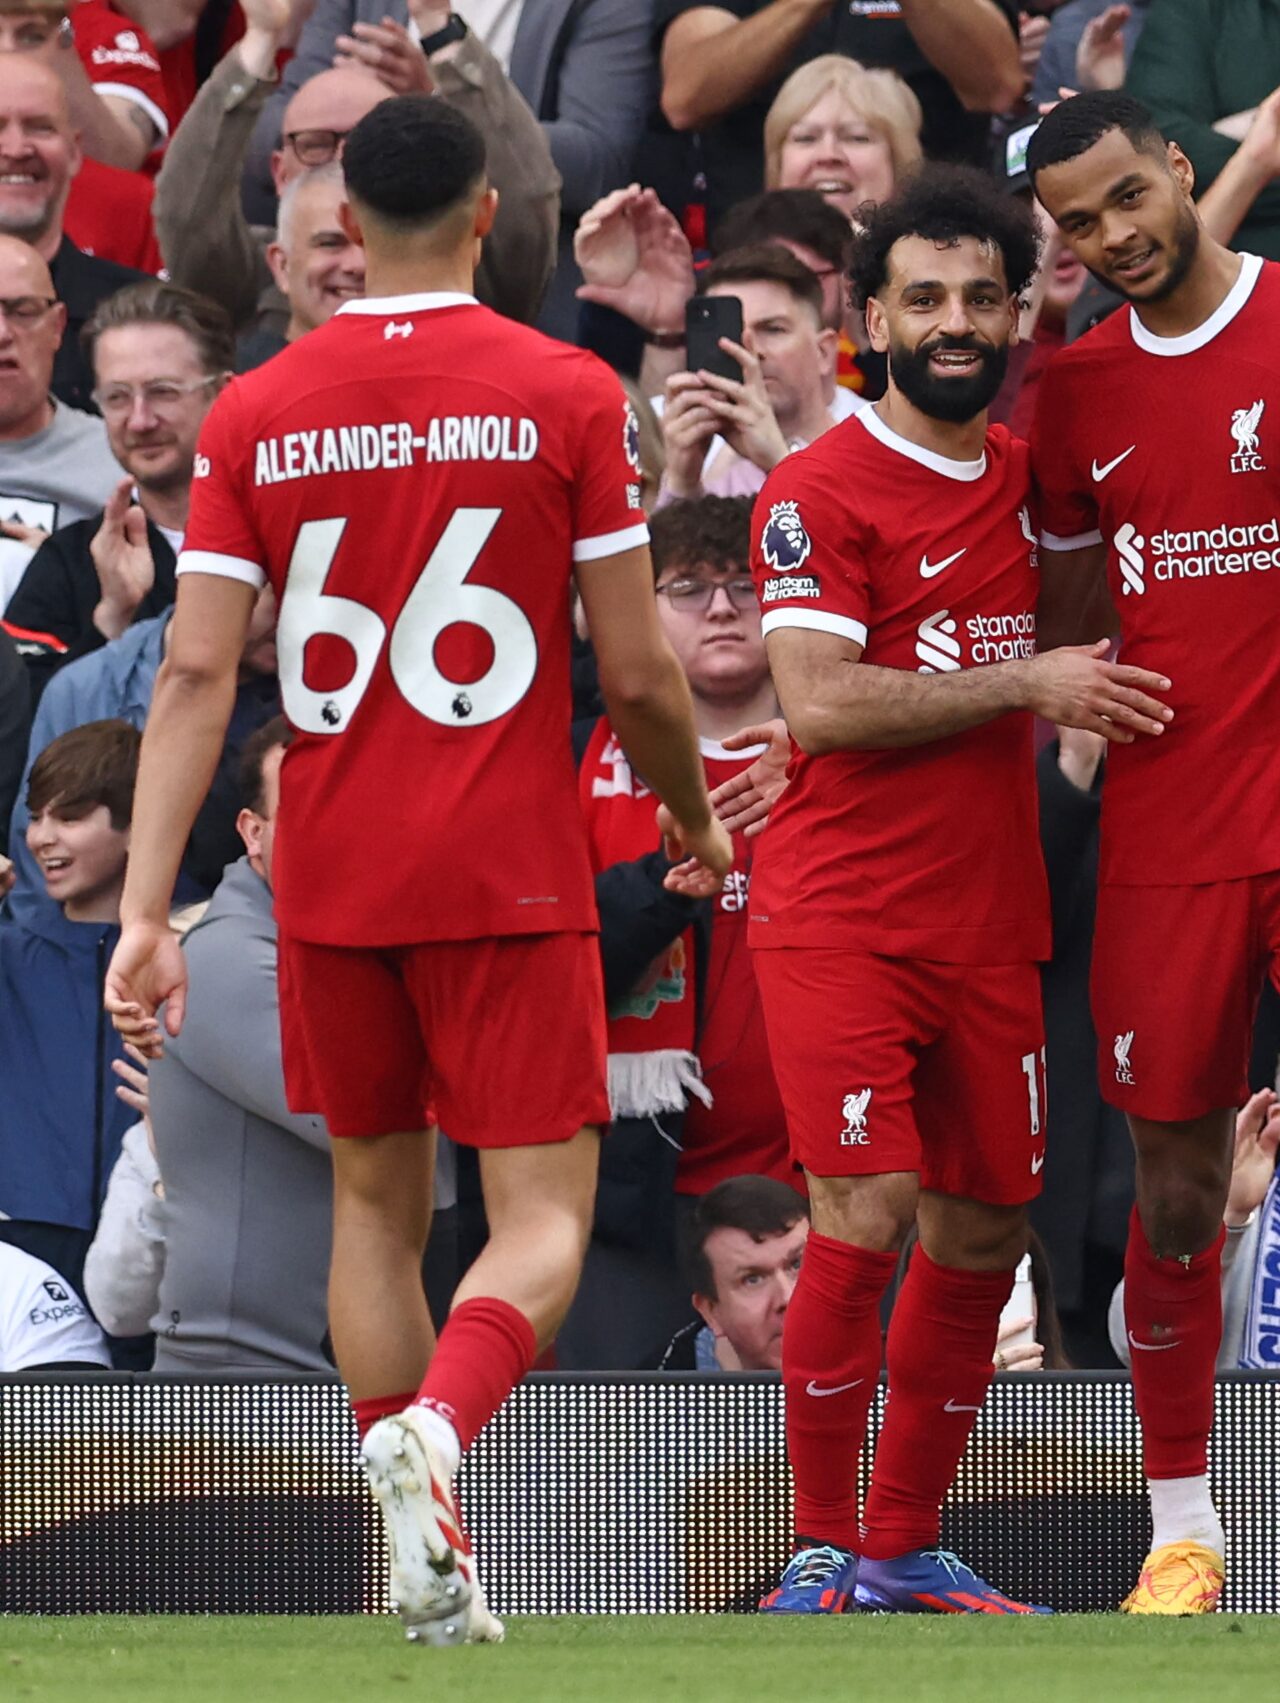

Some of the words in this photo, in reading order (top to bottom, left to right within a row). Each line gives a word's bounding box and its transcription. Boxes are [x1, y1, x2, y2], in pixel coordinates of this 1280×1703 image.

[254, 415, 539, 487] ALEXANDER-ARNOLD
[1150, 518, 1280, 556] standard
[779, 576, 813, 589] room
[276, 507, 538, 735] 66
